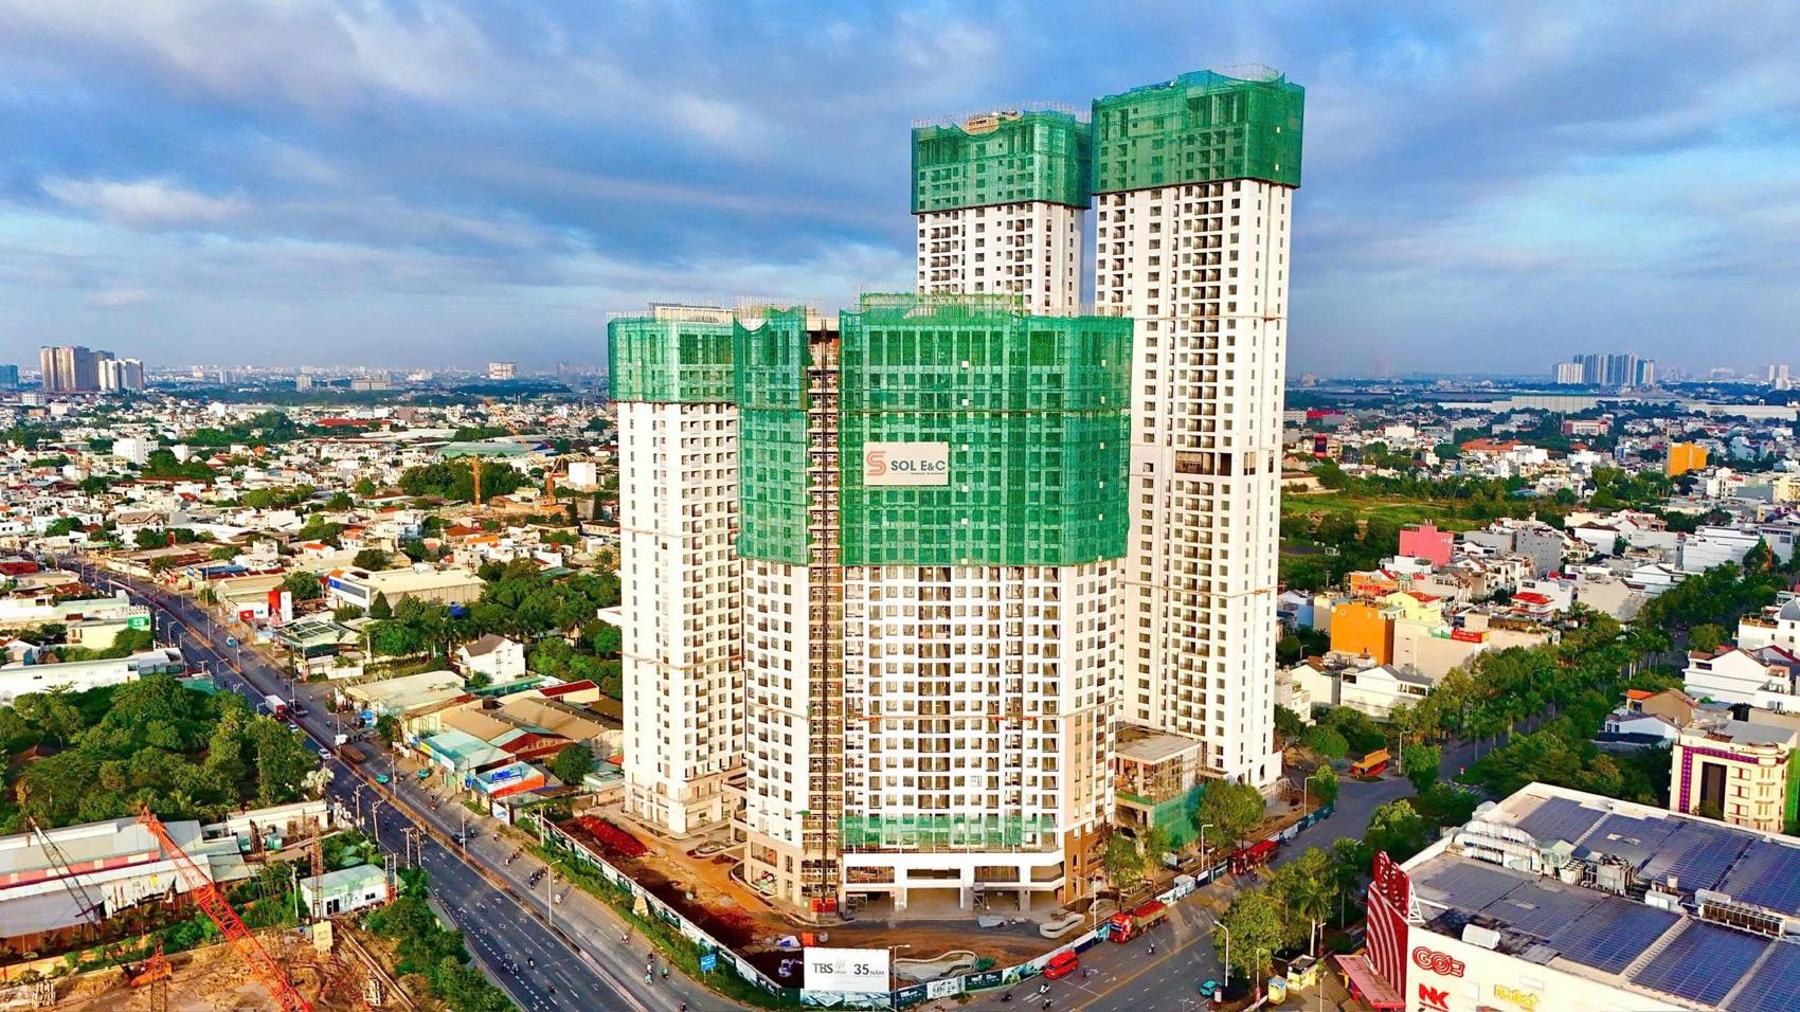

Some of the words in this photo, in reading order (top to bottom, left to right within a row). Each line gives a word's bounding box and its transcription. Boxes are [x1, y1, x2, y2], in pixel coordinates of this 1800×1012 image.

[891, 460, 917, 471] SOL
[920, 460, 946, 471] E&C
[813, 963, 833, 974] TBS
[854, 963, 869, 975] 35
[1418, 983, 1449, 1009] NK
